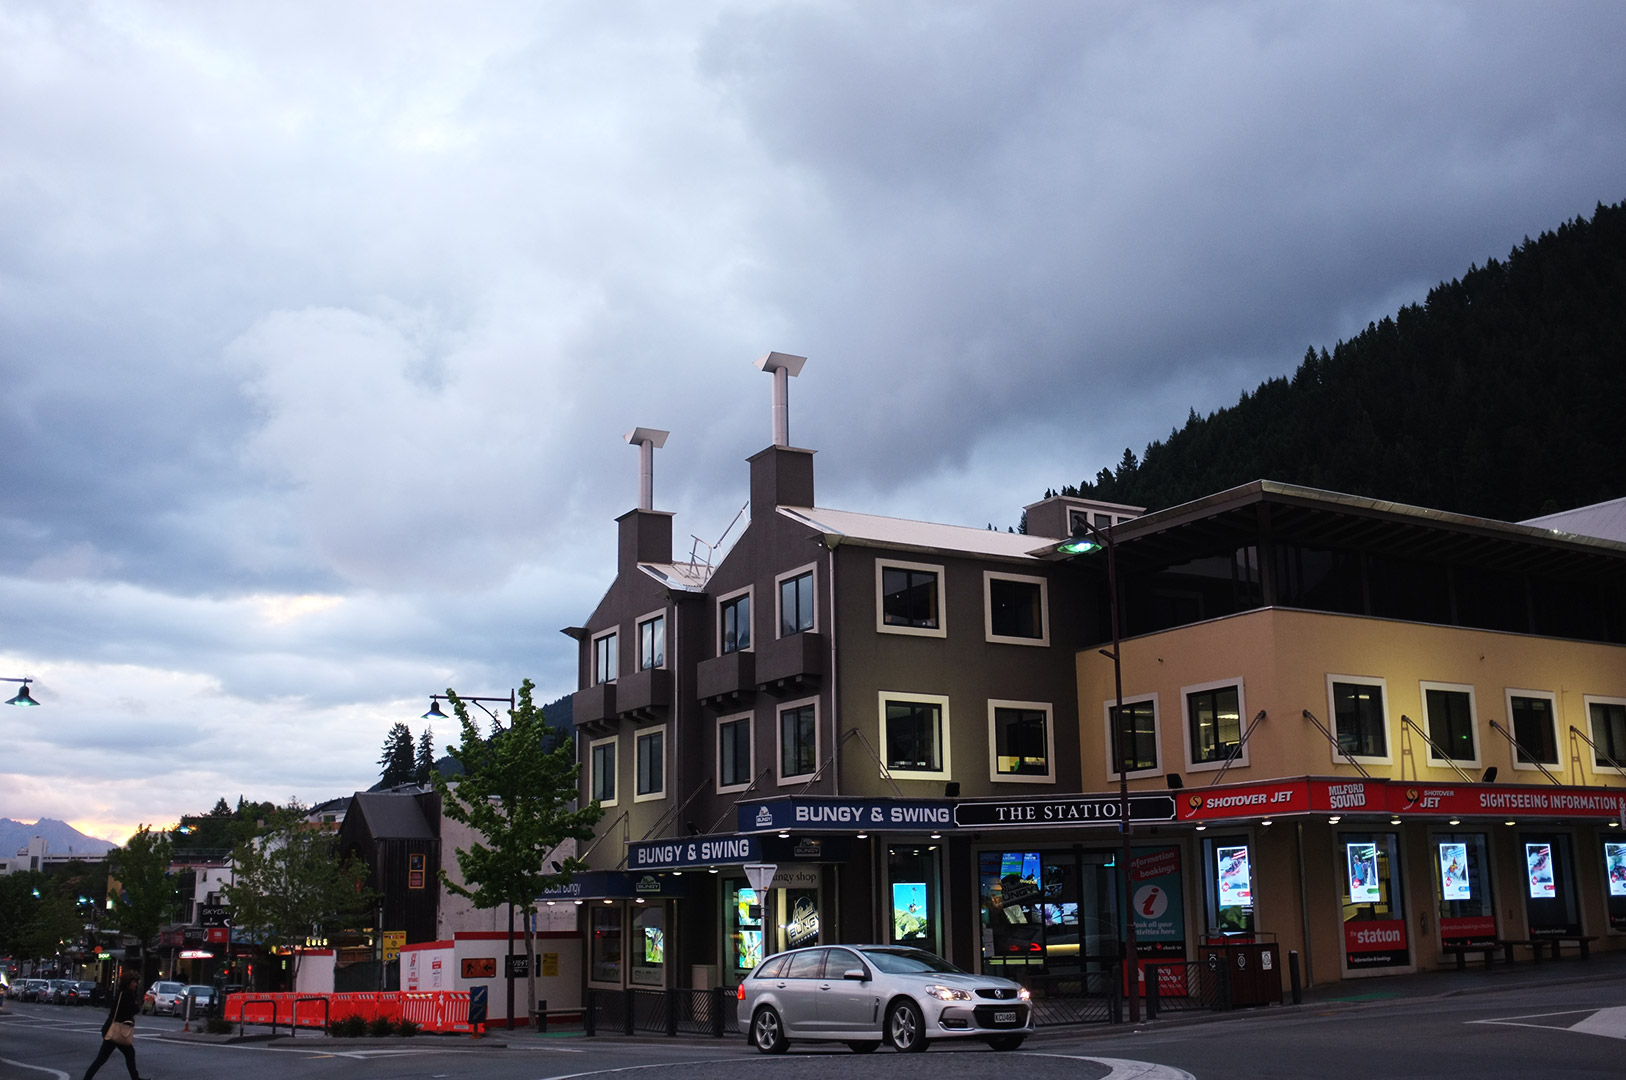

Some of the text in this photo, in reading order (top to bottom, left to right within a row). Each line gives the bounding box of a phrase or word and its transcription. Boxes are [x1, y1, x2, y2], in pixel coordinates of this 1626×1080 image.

[1328, 783, 1364, 796] MILFORD
[1206, 790, 1293, 808] SHOTOVER JET
[1330, 793, 1366, 809] SOUND
[1420, 797, 1441, 808] JET
[1480, 793, 1548, 808] SIGHTSEEING
[1550, 795, 1617, 810] INFORMATION
[796, 806, 949, 822] BUNGY & SWING
[995, 806, 1036, 821] THE
[638, 839, 749, 864] BUNGY & SWING
[1131, 852, 1175, 868] nformation
[773, 872, 816, 884] ungy shop
[1139, 864, 1175, 878] bookings
[789, 915, 820, 938] BUNG
[1136, 927, 1176, 936] tivities here
[1357, 928, 1400, 944] station
